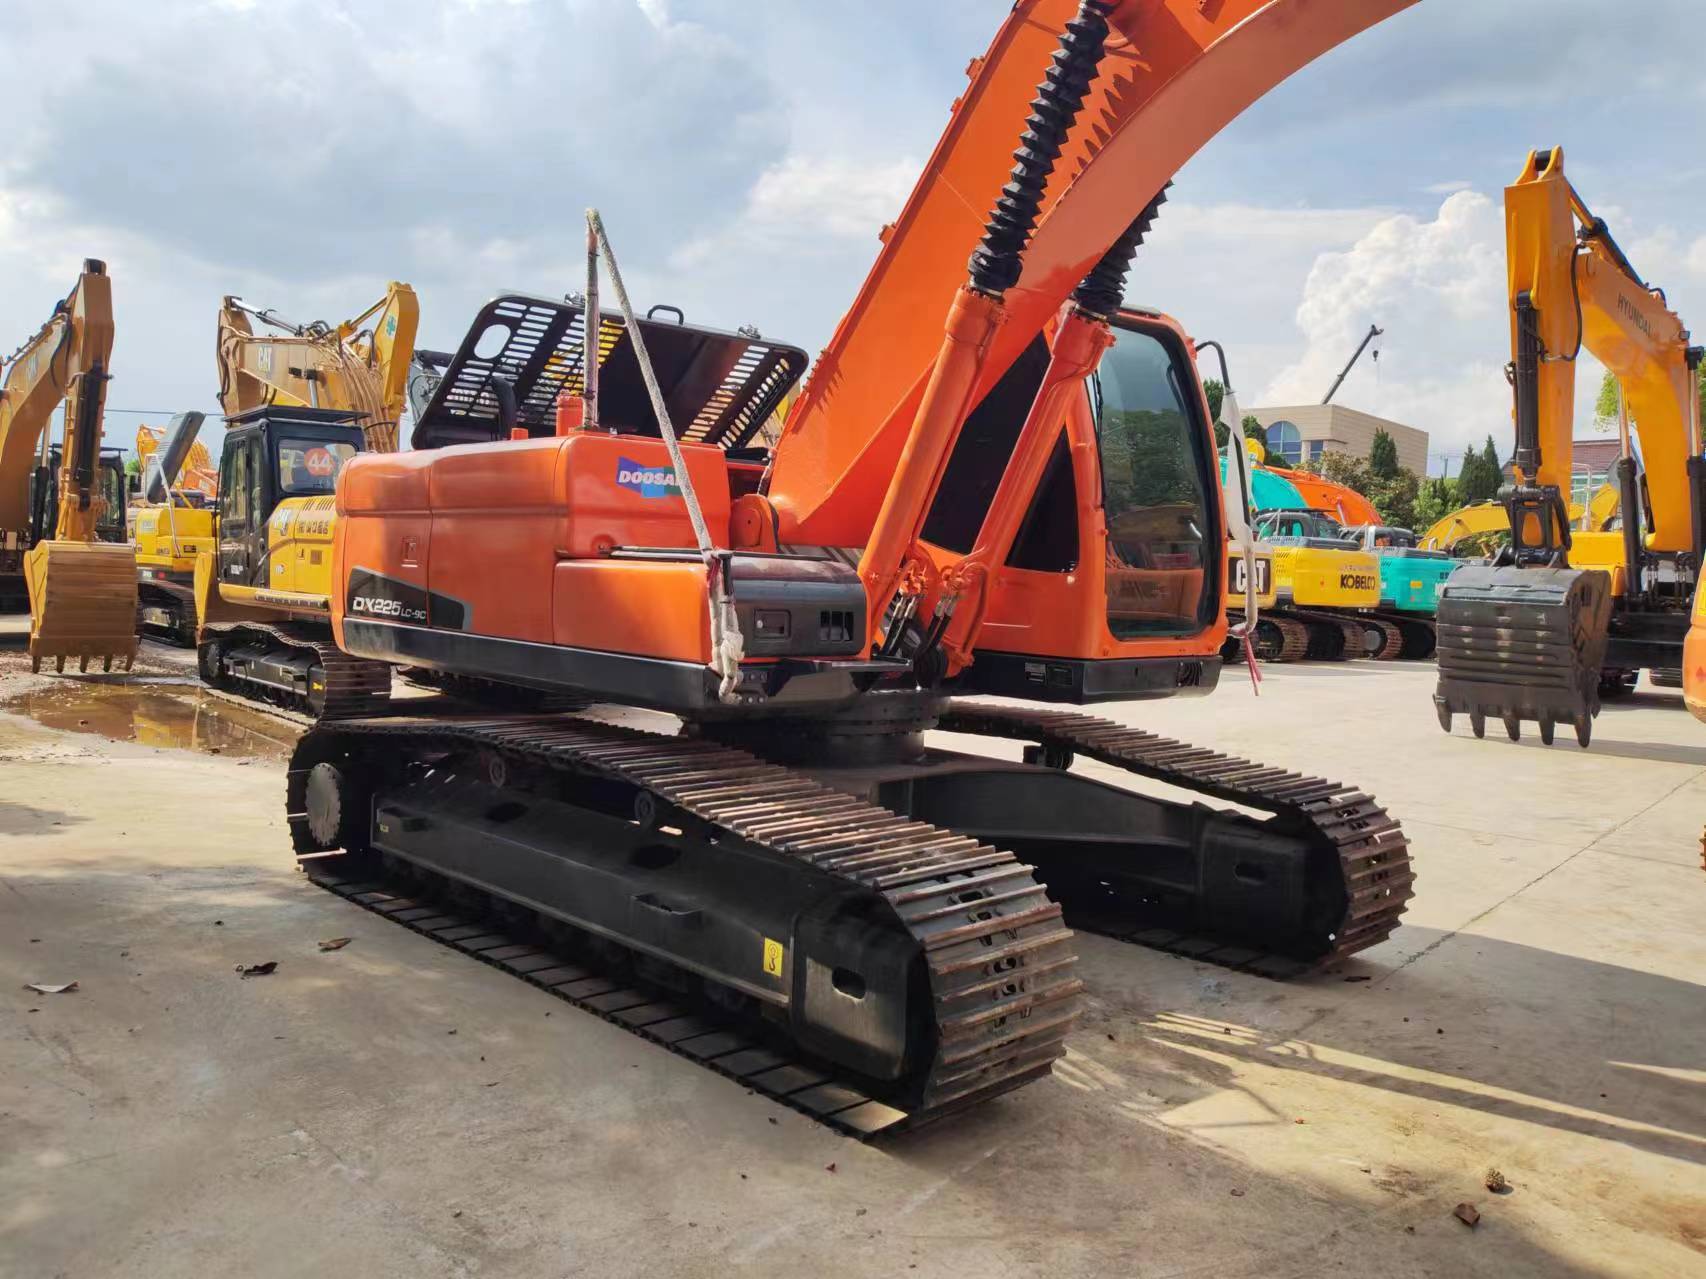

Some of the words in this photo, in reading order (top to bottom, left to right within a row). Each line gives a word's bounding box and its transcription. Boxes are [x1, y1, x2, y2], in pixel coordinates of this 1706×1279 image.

[1617, 291, 1652, 338] HYUNDAI
[308, 453, 333, 476] 44
[618, 470, 682, 486] DOOSA
[1236, 559, 1266, 593] CT
[1340, 574, 1376, 591] KOBELCO
